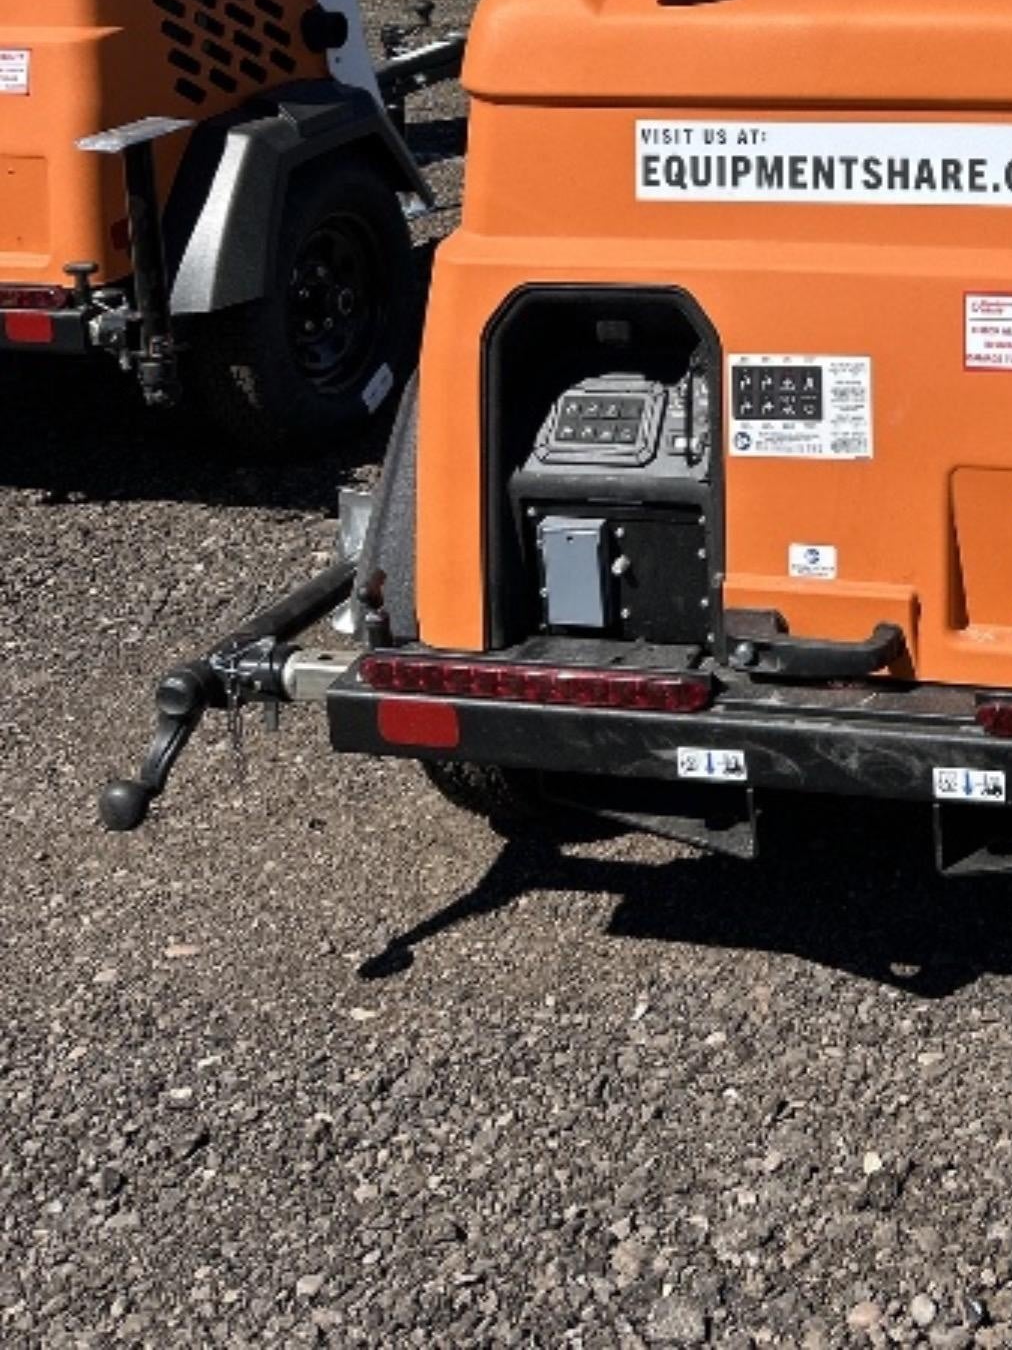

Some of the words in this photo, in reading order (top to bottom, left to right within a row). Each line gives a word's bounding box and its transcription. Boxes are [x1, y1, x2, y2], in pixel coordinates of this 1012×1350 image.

[640, 128, 693, 145] VISIT
[703, 128, 727, 145] US
[736, 128, 768, 145] AT:
